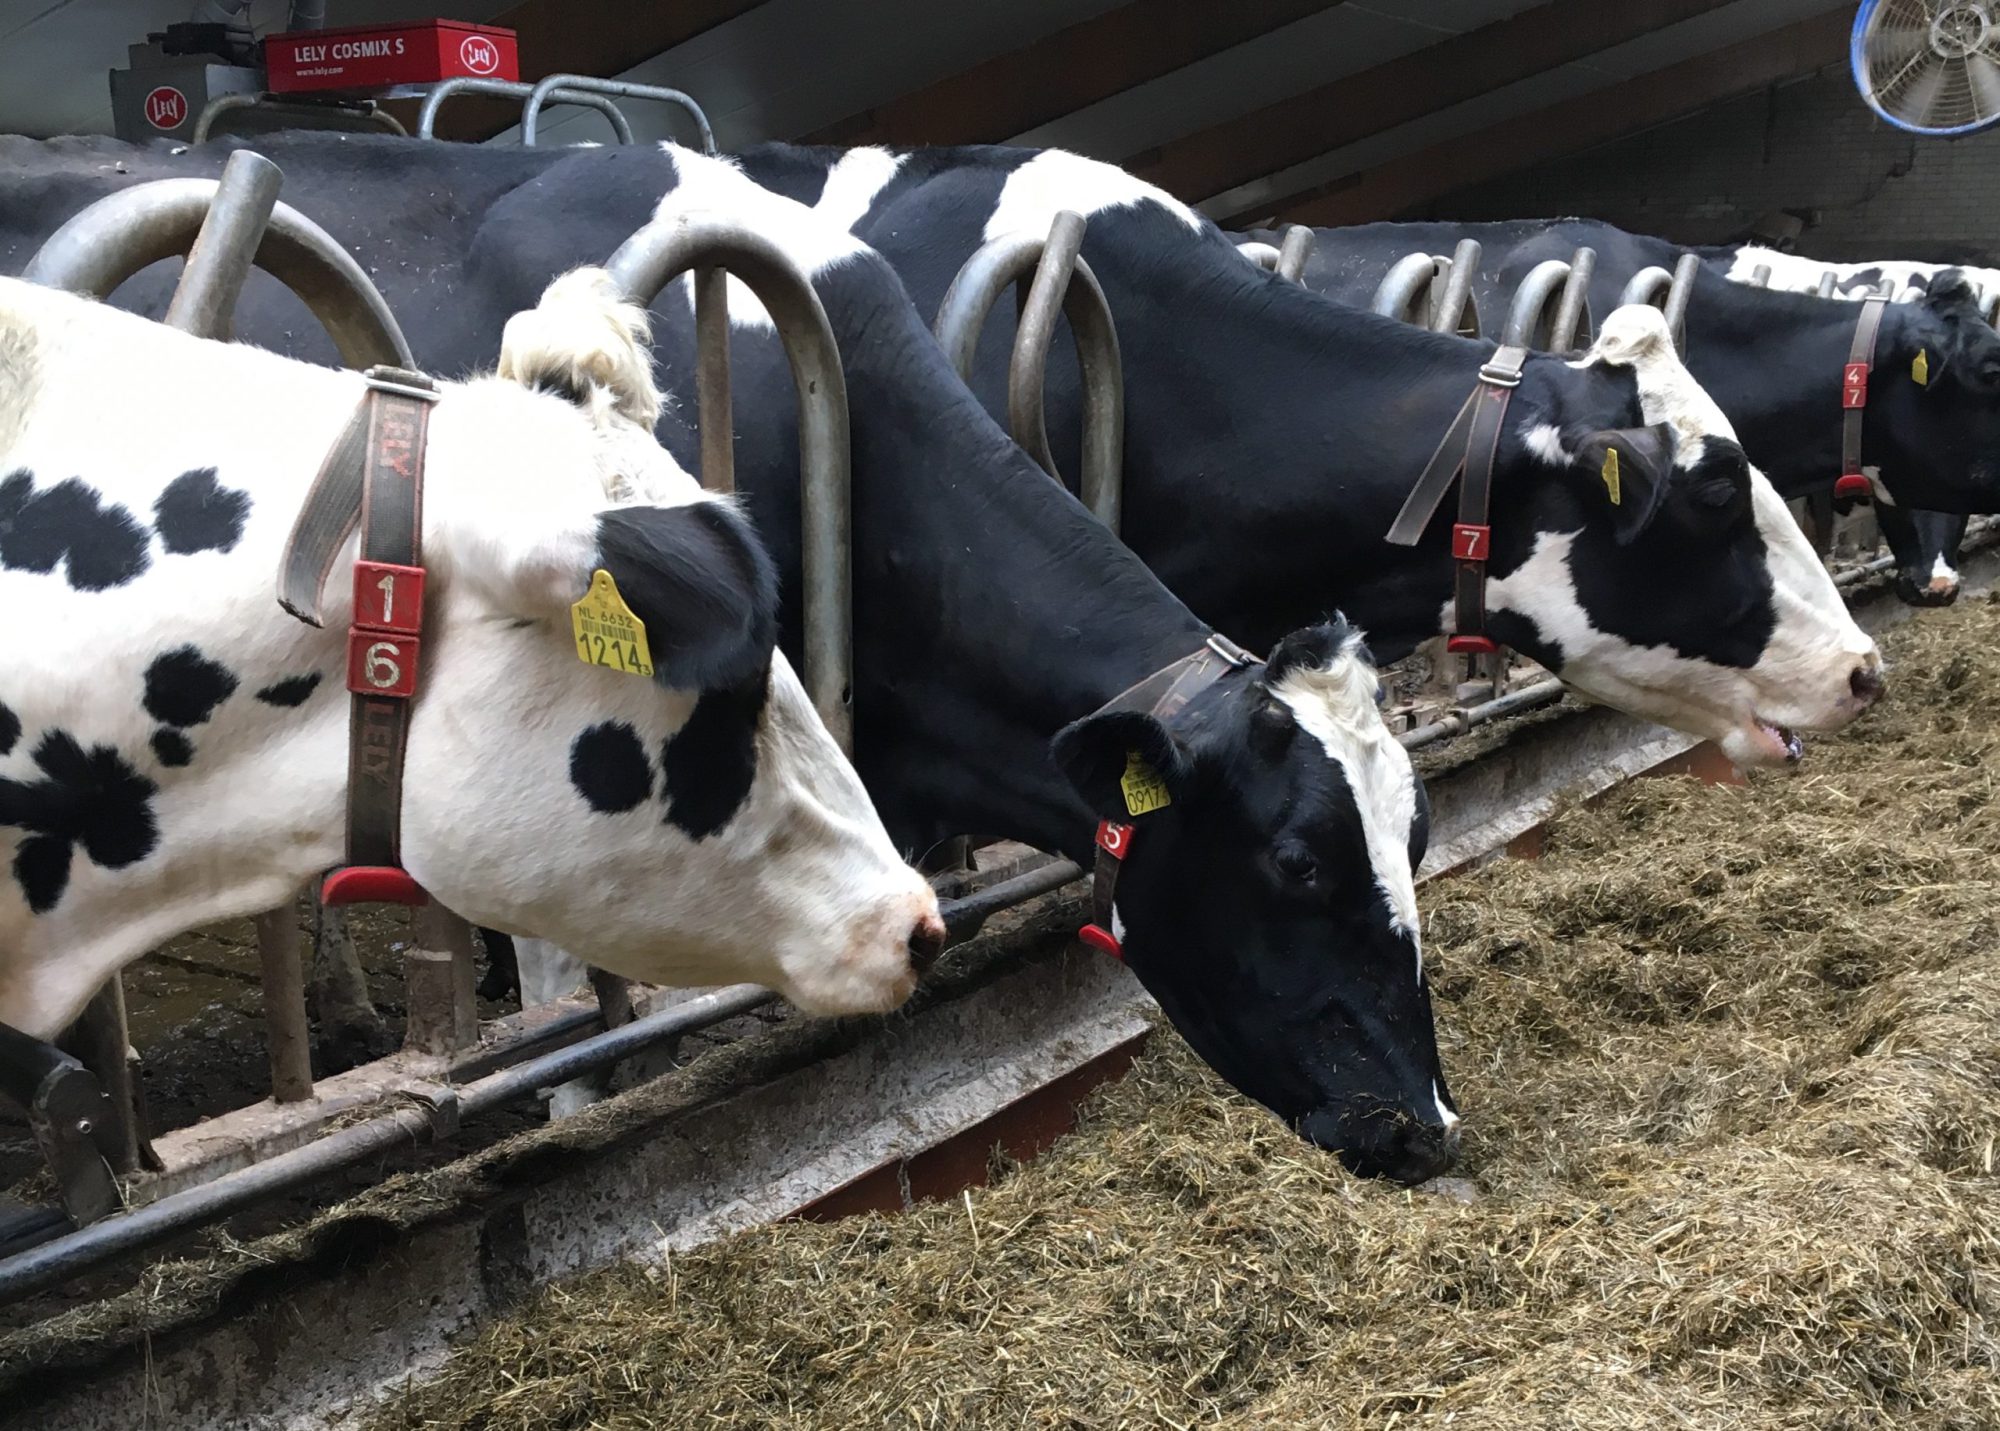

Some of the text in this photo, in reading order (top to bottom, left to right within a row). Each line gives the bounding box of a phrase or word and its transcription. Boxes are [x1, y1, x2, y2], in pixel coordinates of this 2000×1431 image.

[295, 38, 404, 63] LELY COSMIX S
[468, 43, 490, 67] LELY
[296, 67, 344, 77] www.lely.com
[153, 94, 178, 122] LELY
[1848, 367, 1860, 384] 4
[1849, 388, 1860, 405] 7
[1461, 530, 1480, 556] 7
[377, 575, 394, 622] 1
[578, 606, 633, 629] NL 6632
[365, 642, 400, 688] 6
[579, 632, 642, 674] 1214
[1127, 785, 1159, 813] 0917
[1104, 821, 1124, 849] 5
